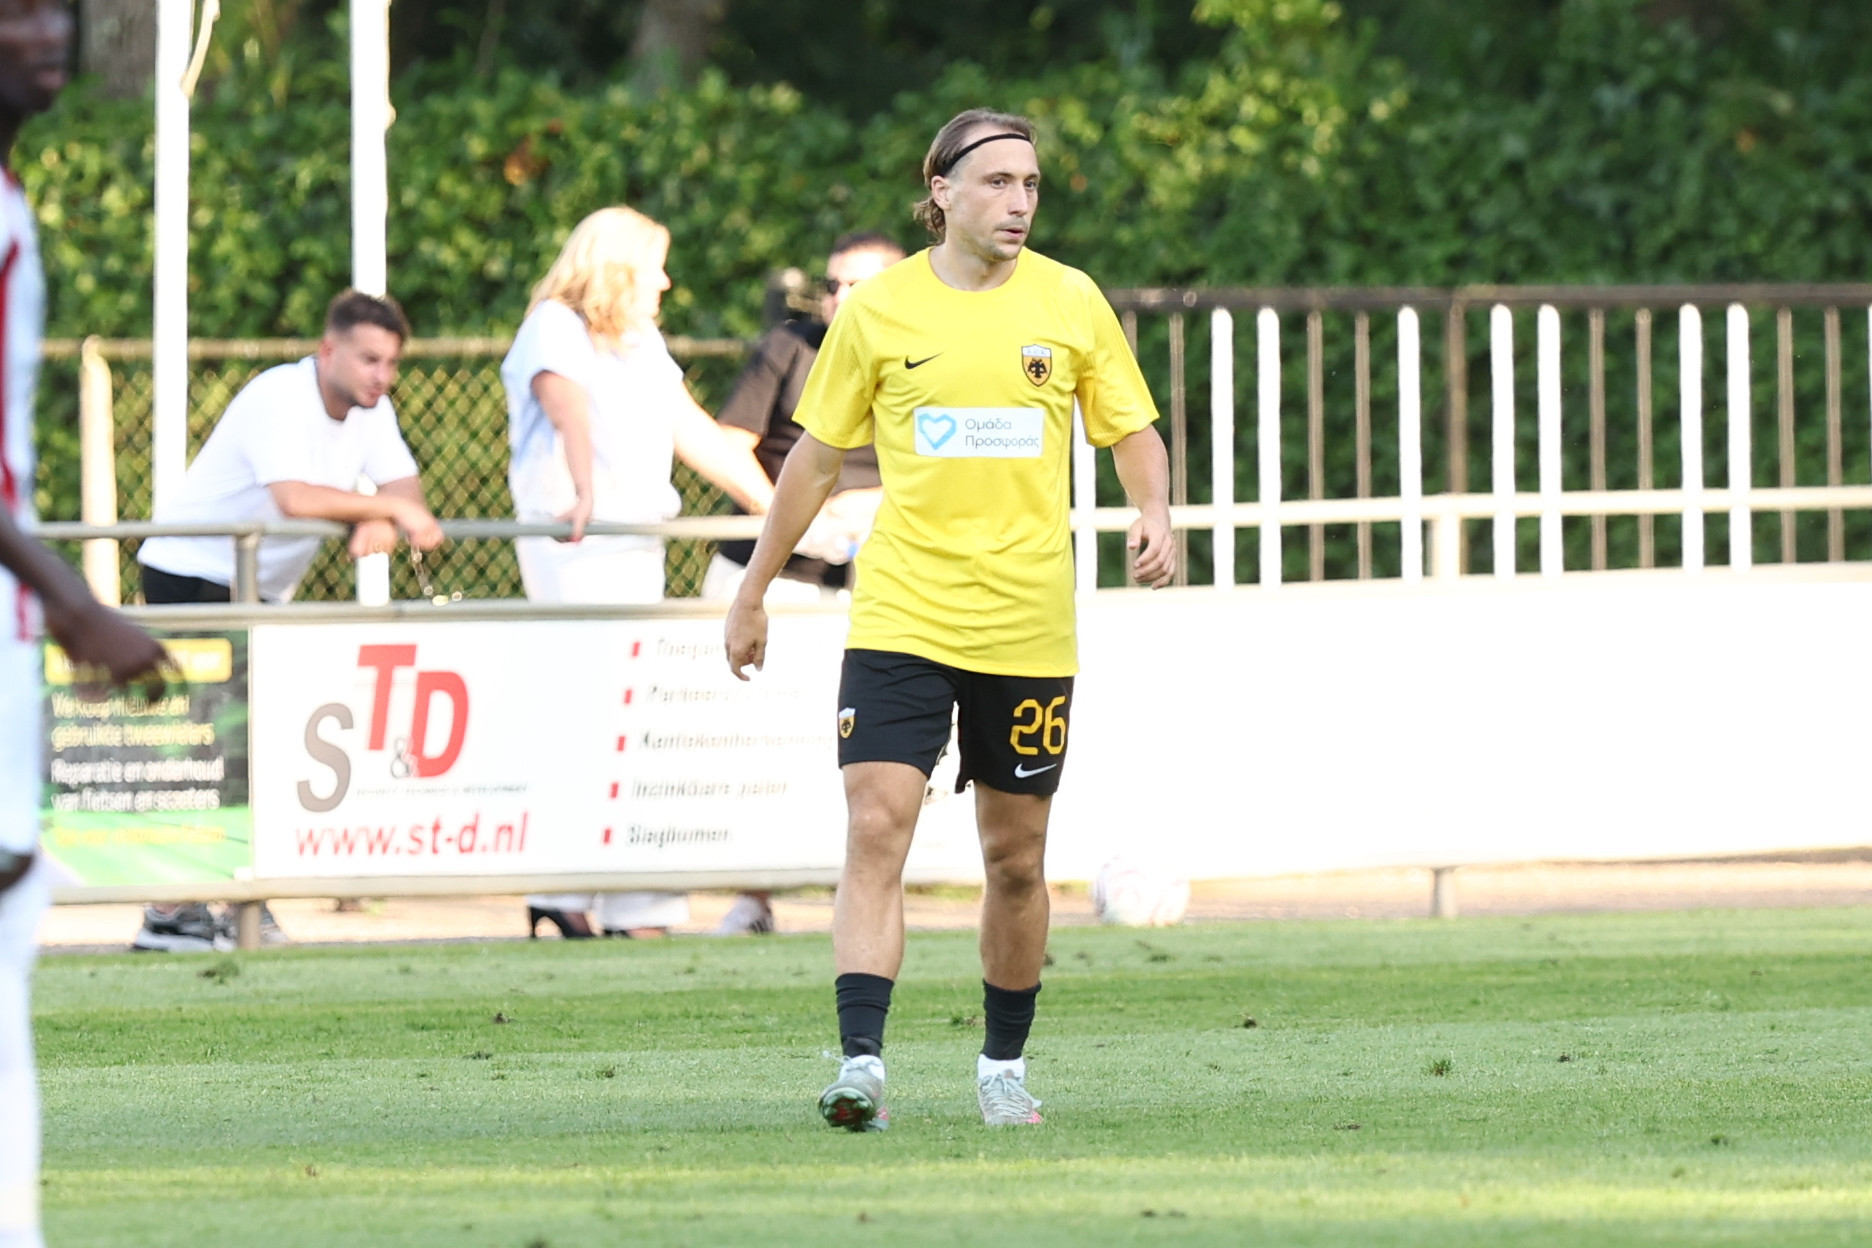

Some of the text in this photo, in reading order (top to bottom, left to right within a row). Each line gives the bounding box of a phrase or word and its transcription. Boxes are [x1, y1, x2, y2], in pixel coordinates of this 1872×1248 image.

[965, 418, 1012, 432] Ομάδα
[965, 435, 1040, 450] Προσφοράς
[1010, 695, 1067, 757] 26
[50, 759, 123, 787] Reparatie
[50, 795, 80, 814] van
[82, 789, 133, 813] fietsen
[295, 810, 530, 857] www.st-d.nl
